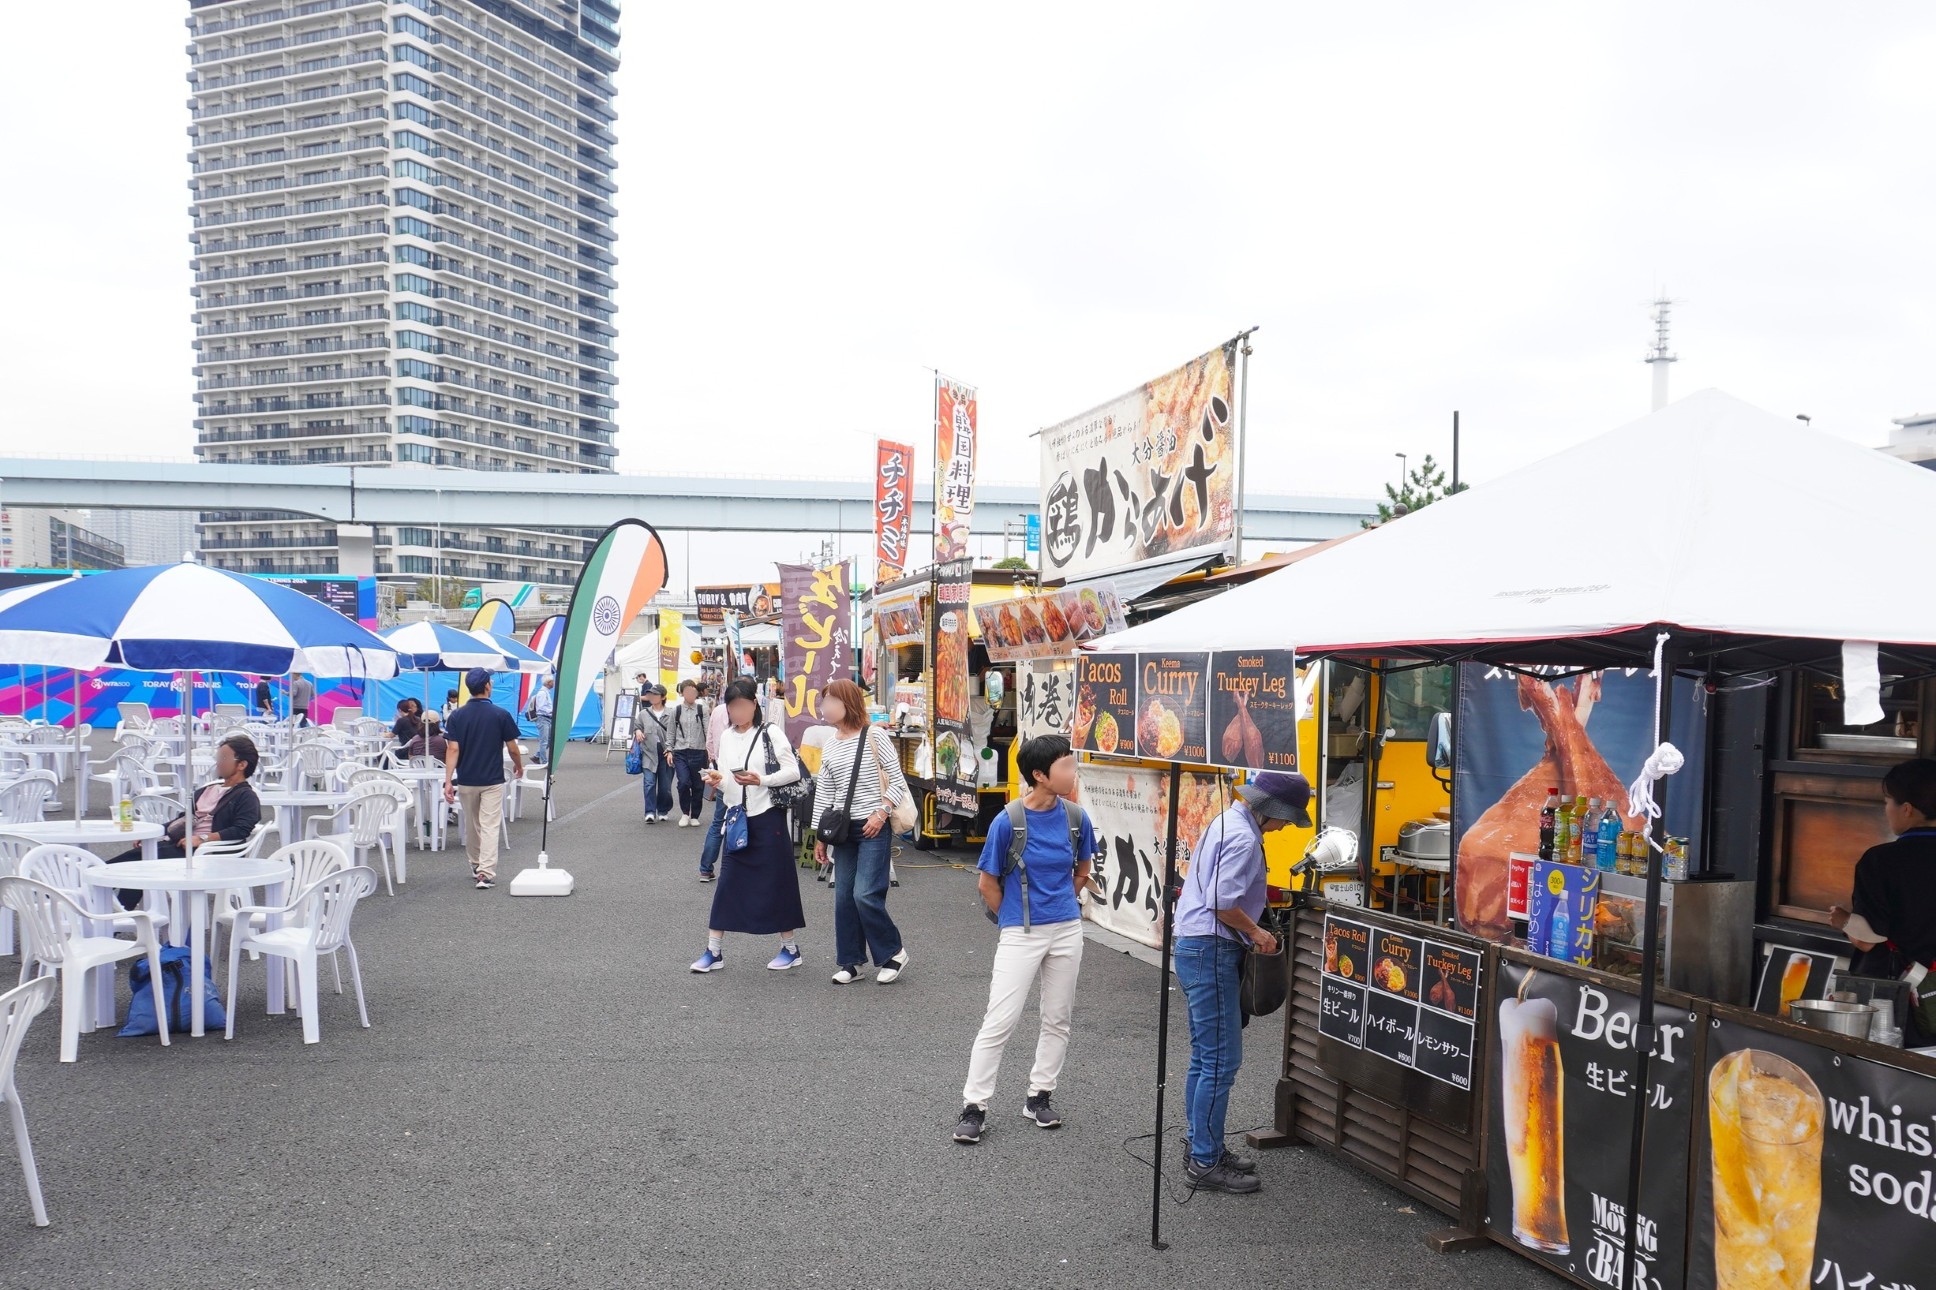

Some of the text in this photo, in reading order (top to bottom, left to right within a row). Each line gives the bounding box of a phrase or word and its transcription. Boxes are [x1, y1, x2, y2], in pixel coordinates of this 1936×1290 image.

[947, 407, 972, 508] 韓国料理
[880, 454, 905, 559] チヂミ
[1077, 655, 1122, 683] Tacos
[1238, 656, 1264, 668] Smoked
[1110, 688, 1127, 706] Roll
[1144, 662, 1198, 706] Curry
[1217, 672, 1286, 699] Turkey Leg
[1268, 752, 1295, 766] ¥1100
[1573, 868, 1599, 966] シリカ水
[1329, 923, 1366, 944] Tacos Roll
[1381, 938, 1411, 962] Curry
[1442, 950, 1460, 961] Smoked
[1427, 955, 1473, 981] Turkey Leg
[1323, 998, 1359, 1024] 生ビール
[1367, 1014, 1415, 1041] ハイボール
[1418, 1032, 1470, 1058] レモンサワー
[1829, 1096, 1936, 1158] whis
